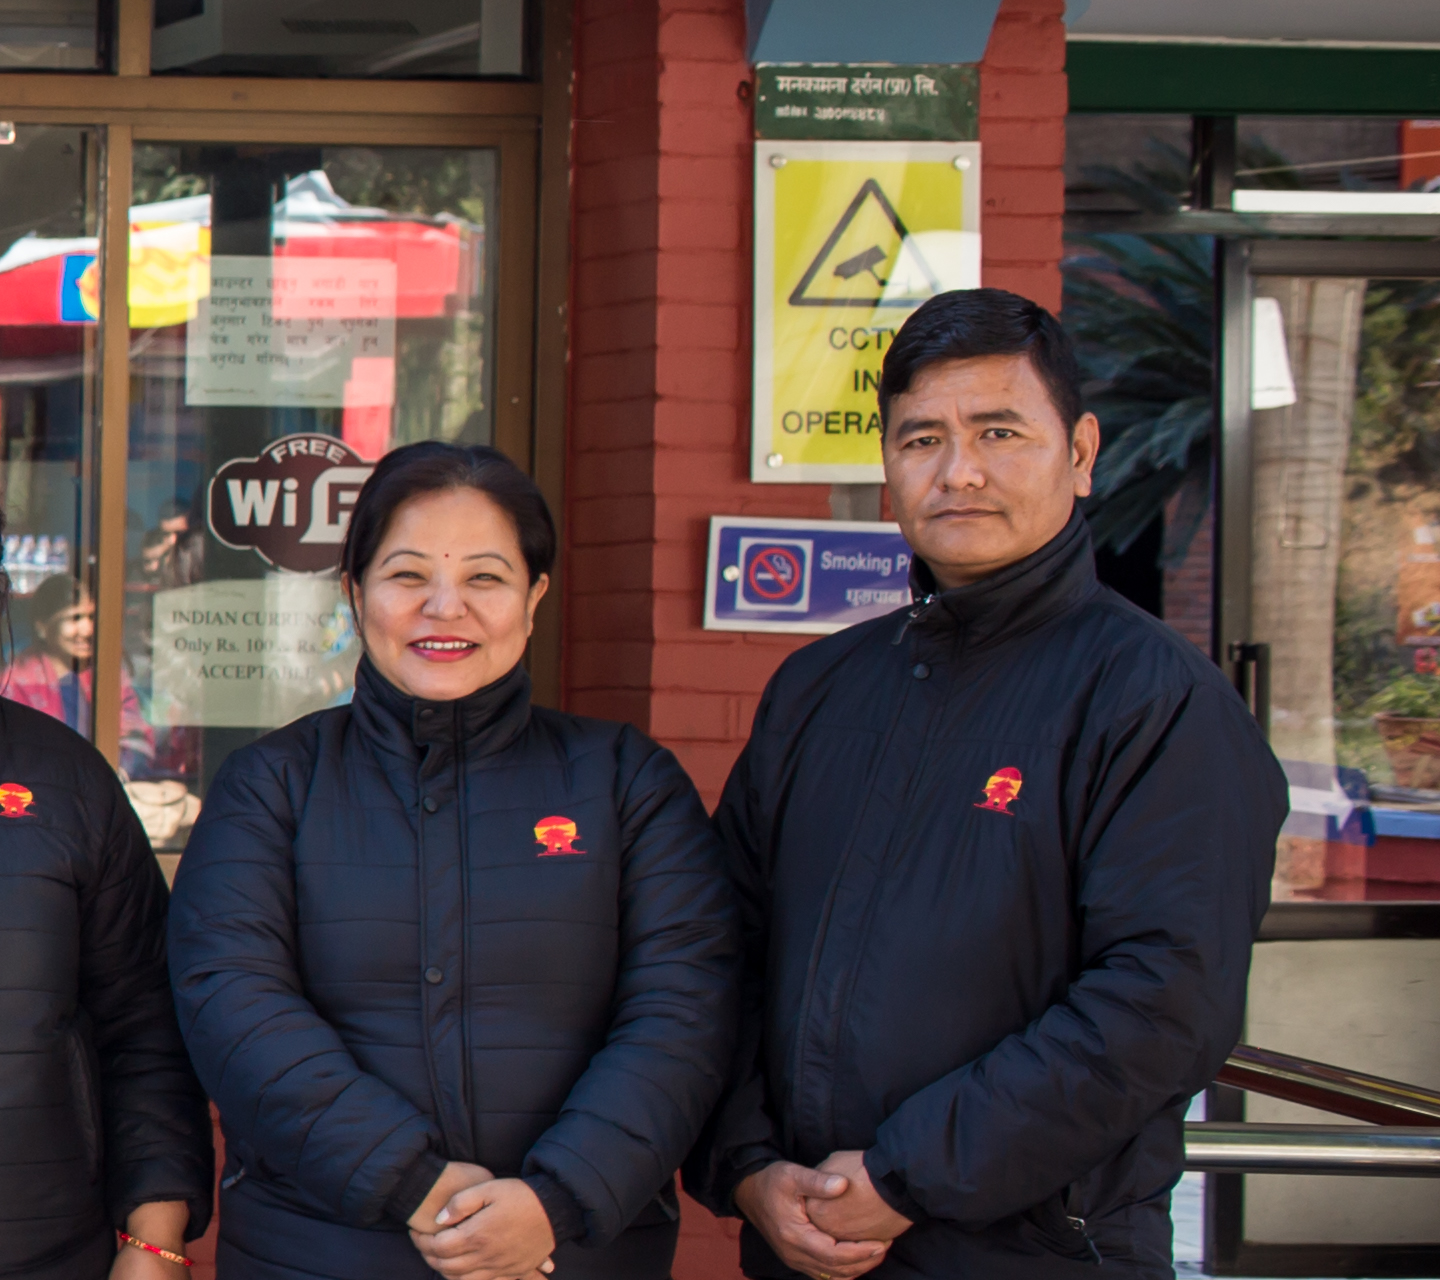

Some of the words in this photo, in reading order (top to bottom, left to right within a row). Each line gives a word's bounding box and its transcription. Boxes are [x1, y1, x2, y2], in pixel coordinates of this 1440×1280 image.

[775, 75, 848, 94] मनकामना
[851, 71, 882, 95] दर्शन
[854, 369, 881, 392] IN
[782, 411, 882, 434] OPERA
[270, 439, 347, 465] FREE
[821, 550, 892, 577] Smoking
[173, 610, 238, 625] INDIAN
[175, 637, 212, 655] Only
